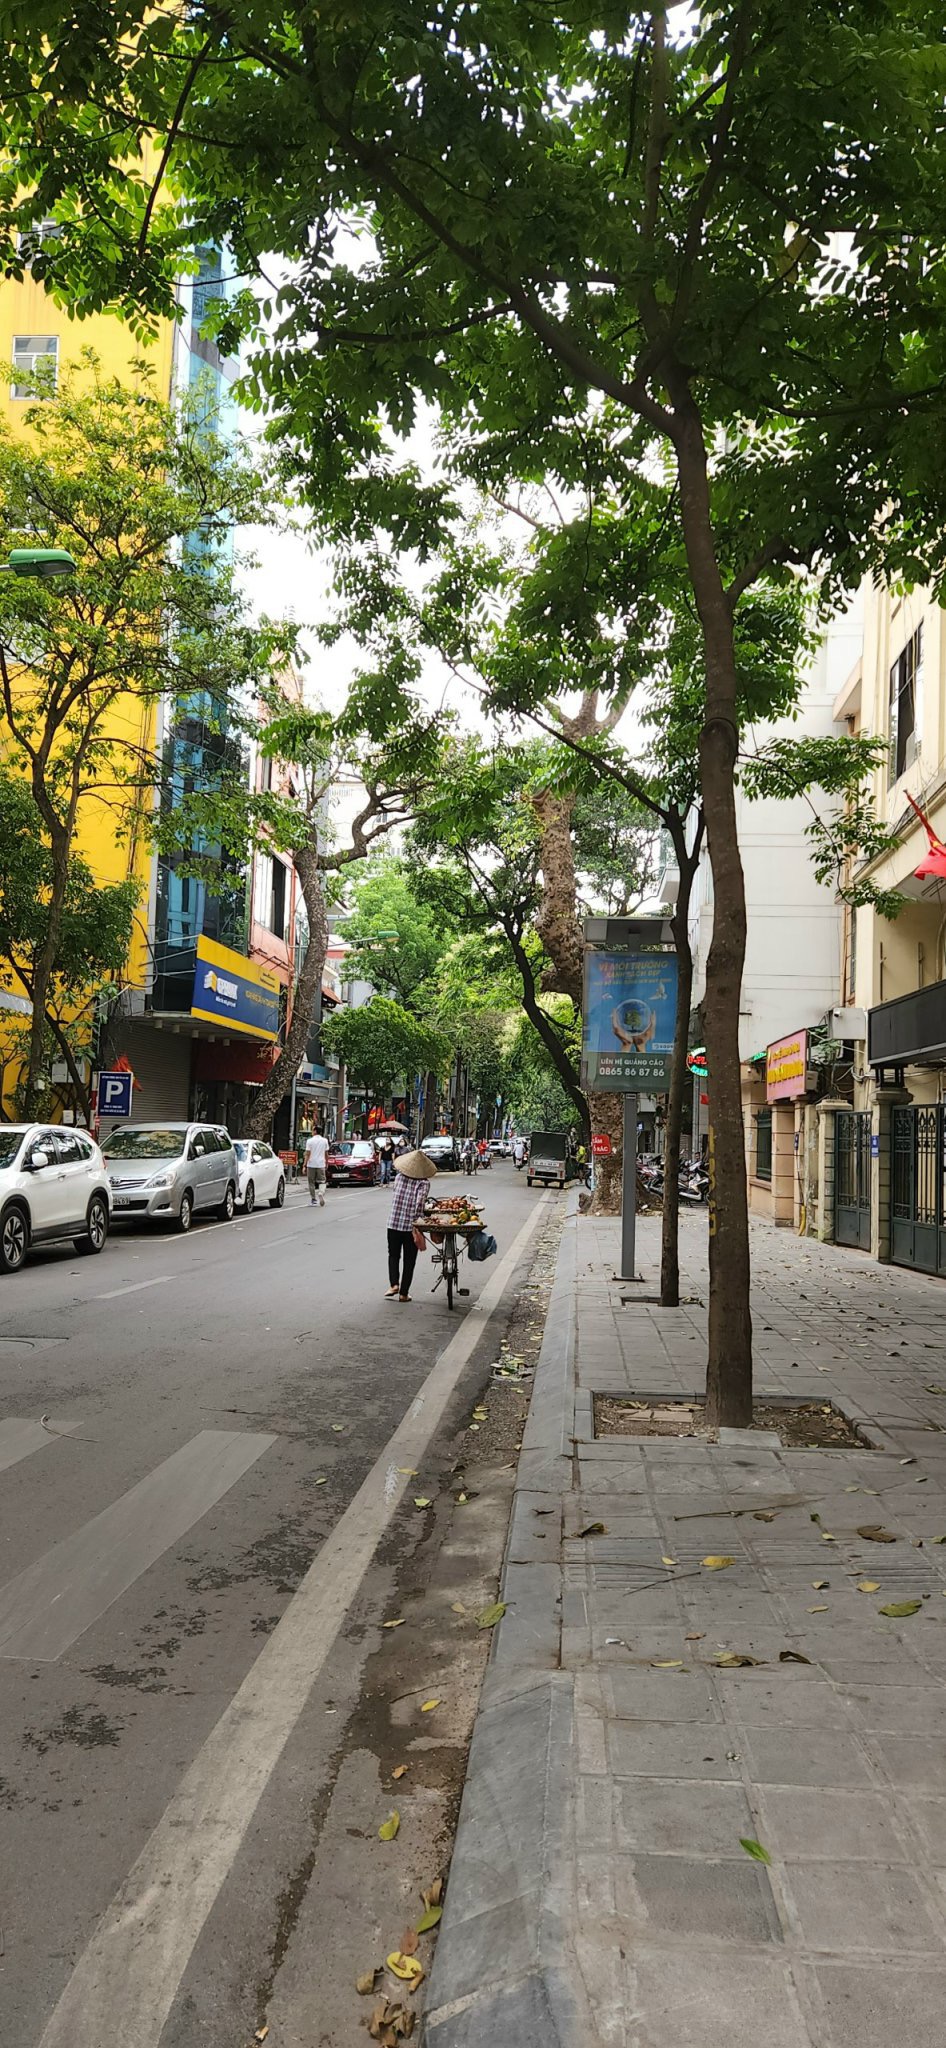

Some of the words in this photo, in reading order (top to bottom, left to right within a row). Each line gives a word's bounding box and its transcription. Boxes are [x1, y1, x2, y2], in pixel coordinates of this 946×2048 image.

[615, 1058, 622, 1066] HỆ
[624, 1058, 647, 1066] QUẢNG
[649, 1058, 664, 1066] CÁO
[599, 1067, 622, 1076] 0865
[624, 1067, 636, 1076] 86
[638, 1068, 650, 1077] 87
[652, 1068, 665, 1077] 86
[105, 1080, 124, 1103] P
